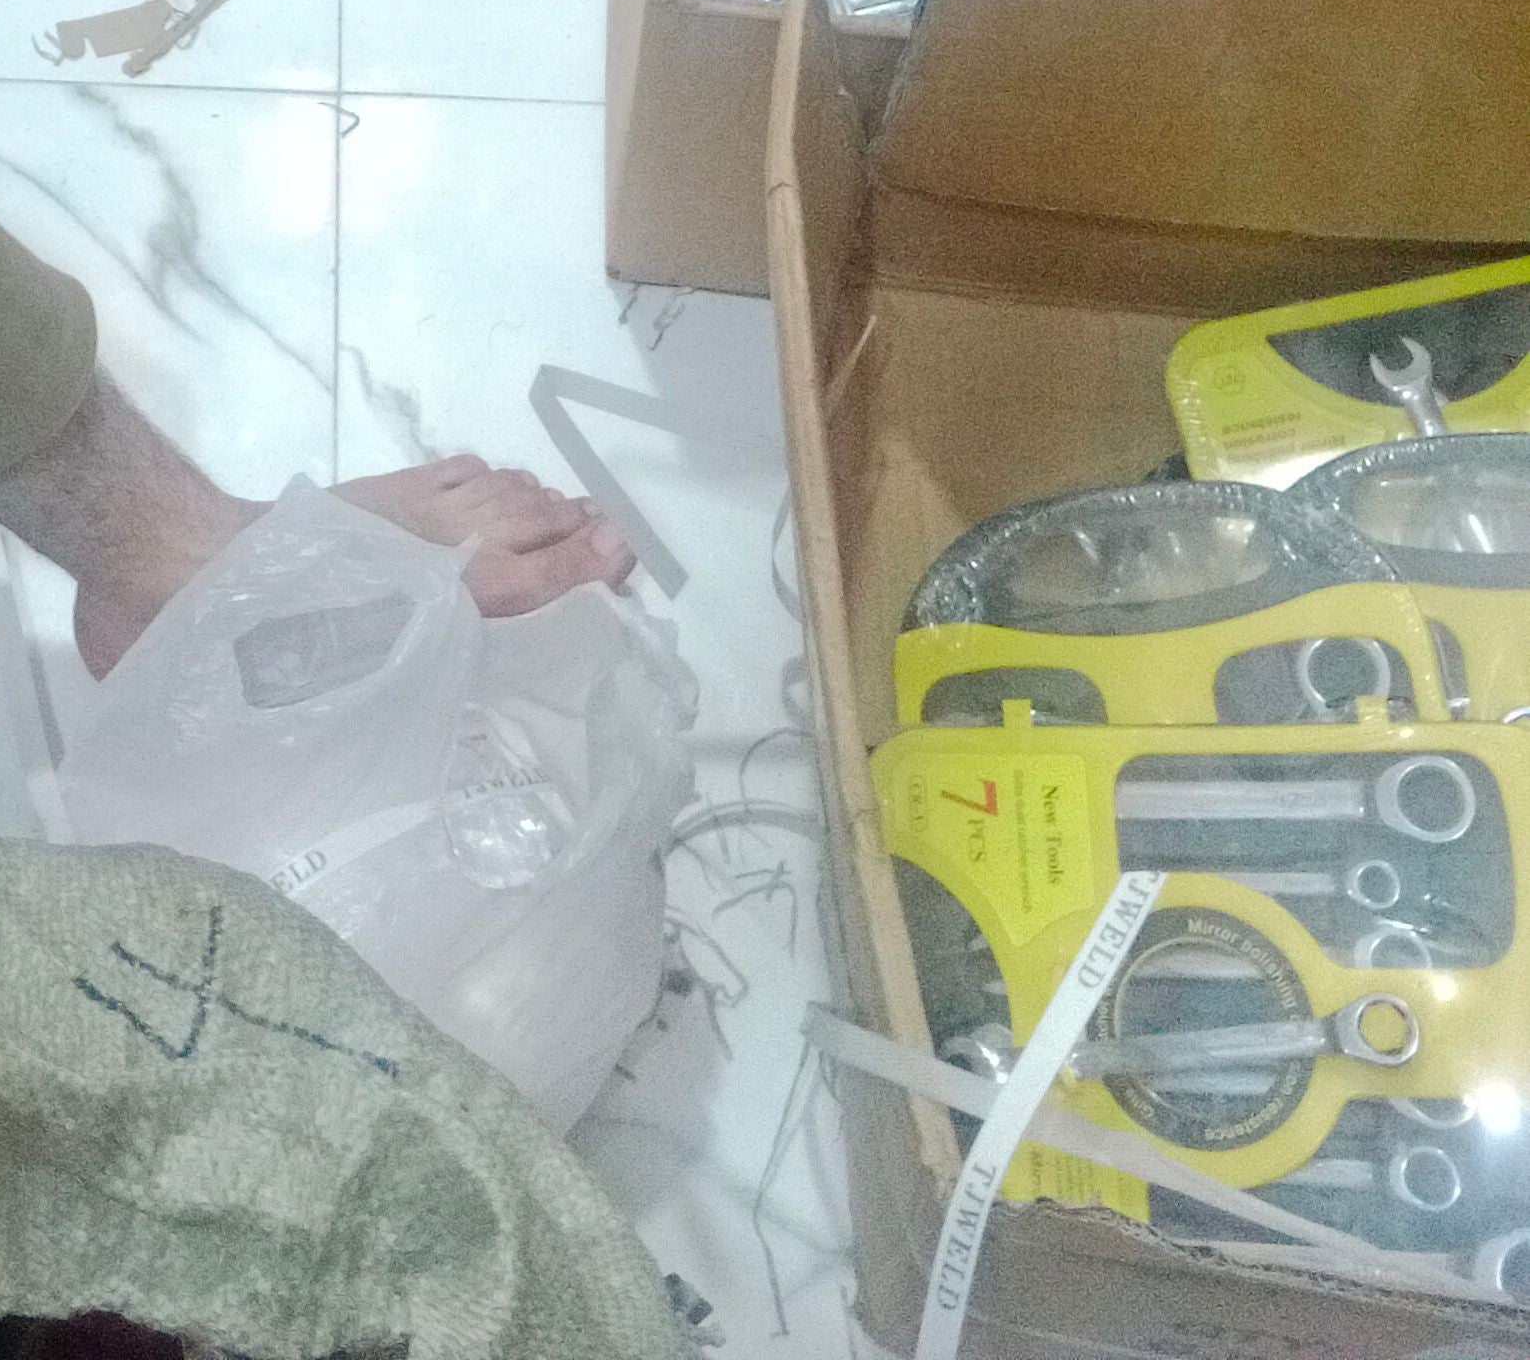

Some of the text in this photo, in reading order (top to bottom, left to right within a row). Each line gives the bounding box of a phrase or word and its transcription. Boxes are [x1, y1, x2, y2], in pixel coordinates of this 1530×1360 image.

[941, 779, 998, 863] 7 PCS
[1042, 784, 1065, 885] New Tools
[270, 848, 328, 894] ELD
[936, 1162, 998, 1312] TJWELD
